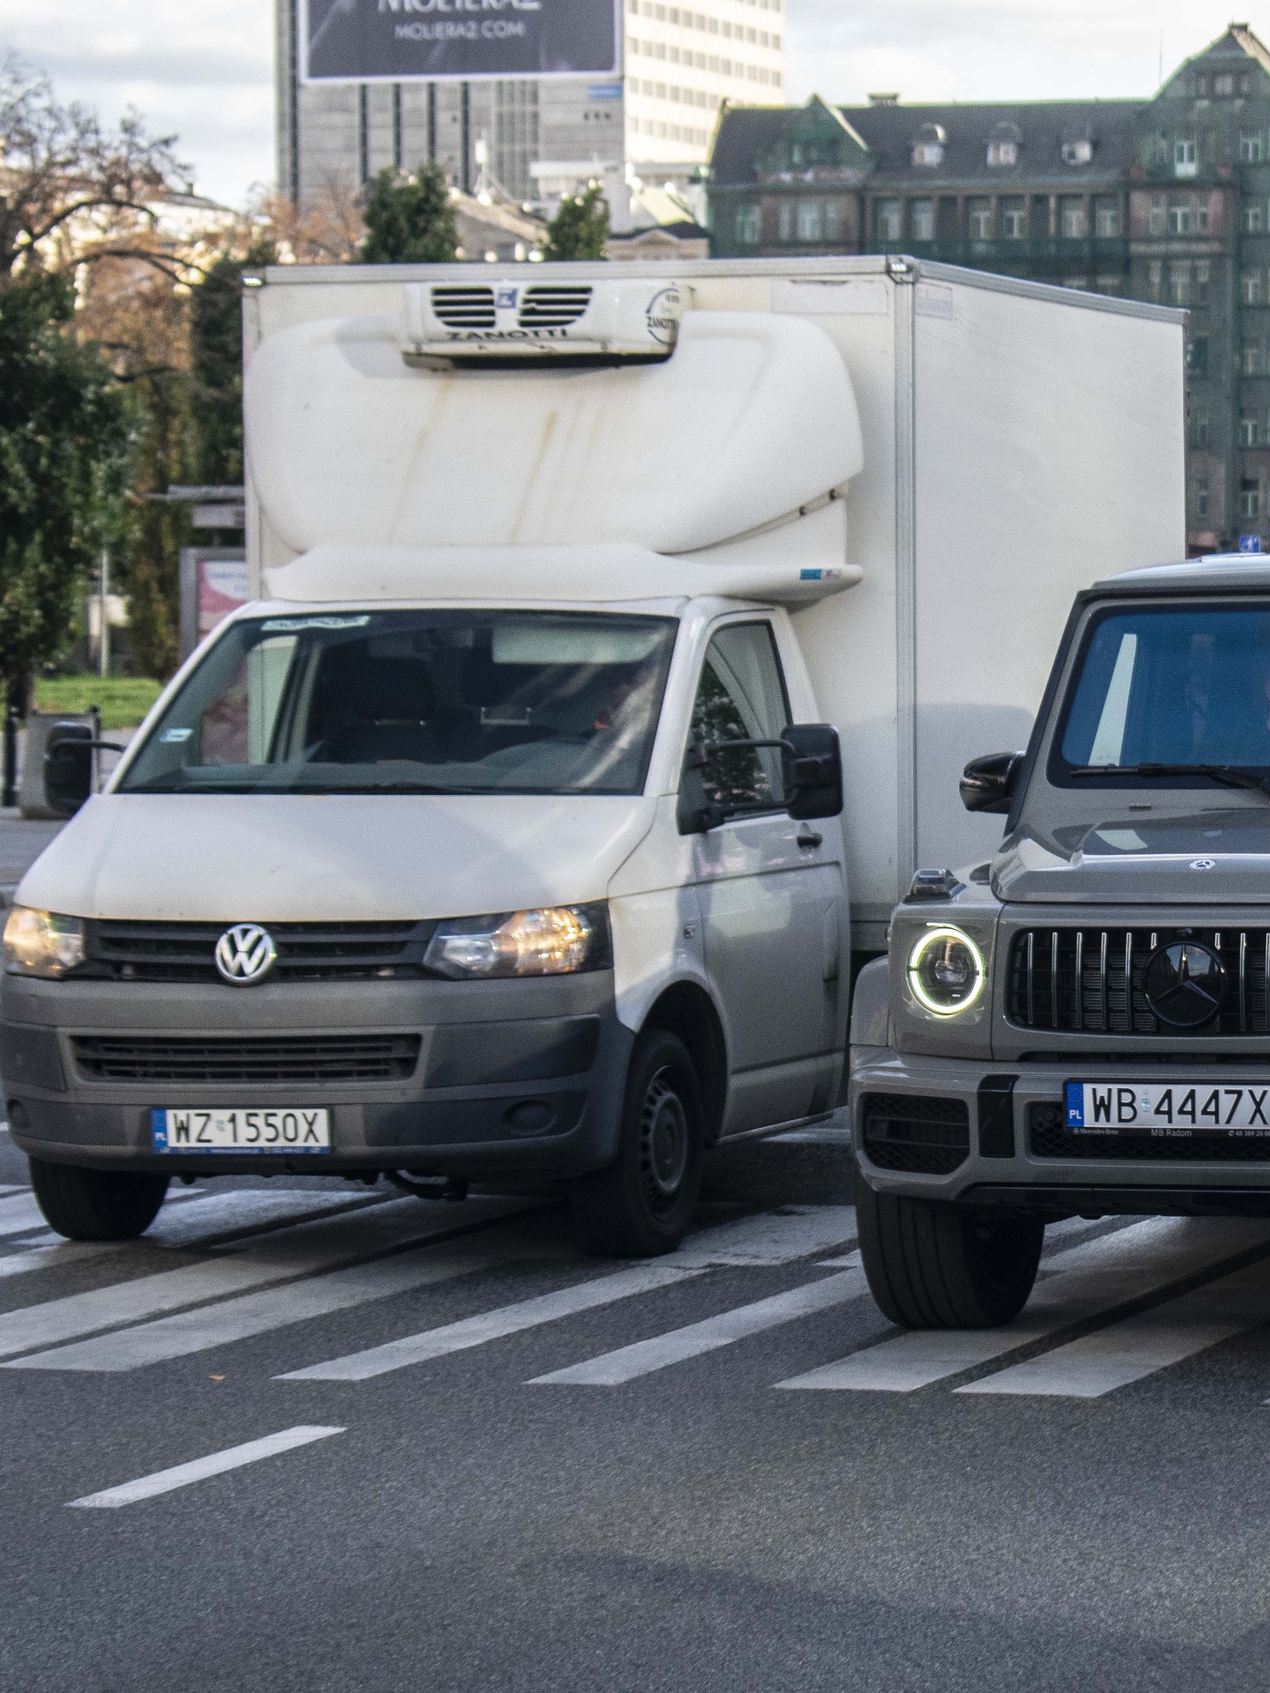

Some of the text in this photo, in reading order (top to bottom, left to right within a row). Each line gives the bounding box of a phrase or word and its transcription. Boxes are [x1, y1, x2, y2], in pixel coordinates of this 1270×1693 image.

[446, 328, 568, 341] ZANOTTI
[1091, 1087, 1269, 1125] WB 4447X
[1069, 1109, 1082, 1120] PL
[173, 1112, 320, 1143] WZ 1550X
[1165, 1129, 1192, 1137] Radom
